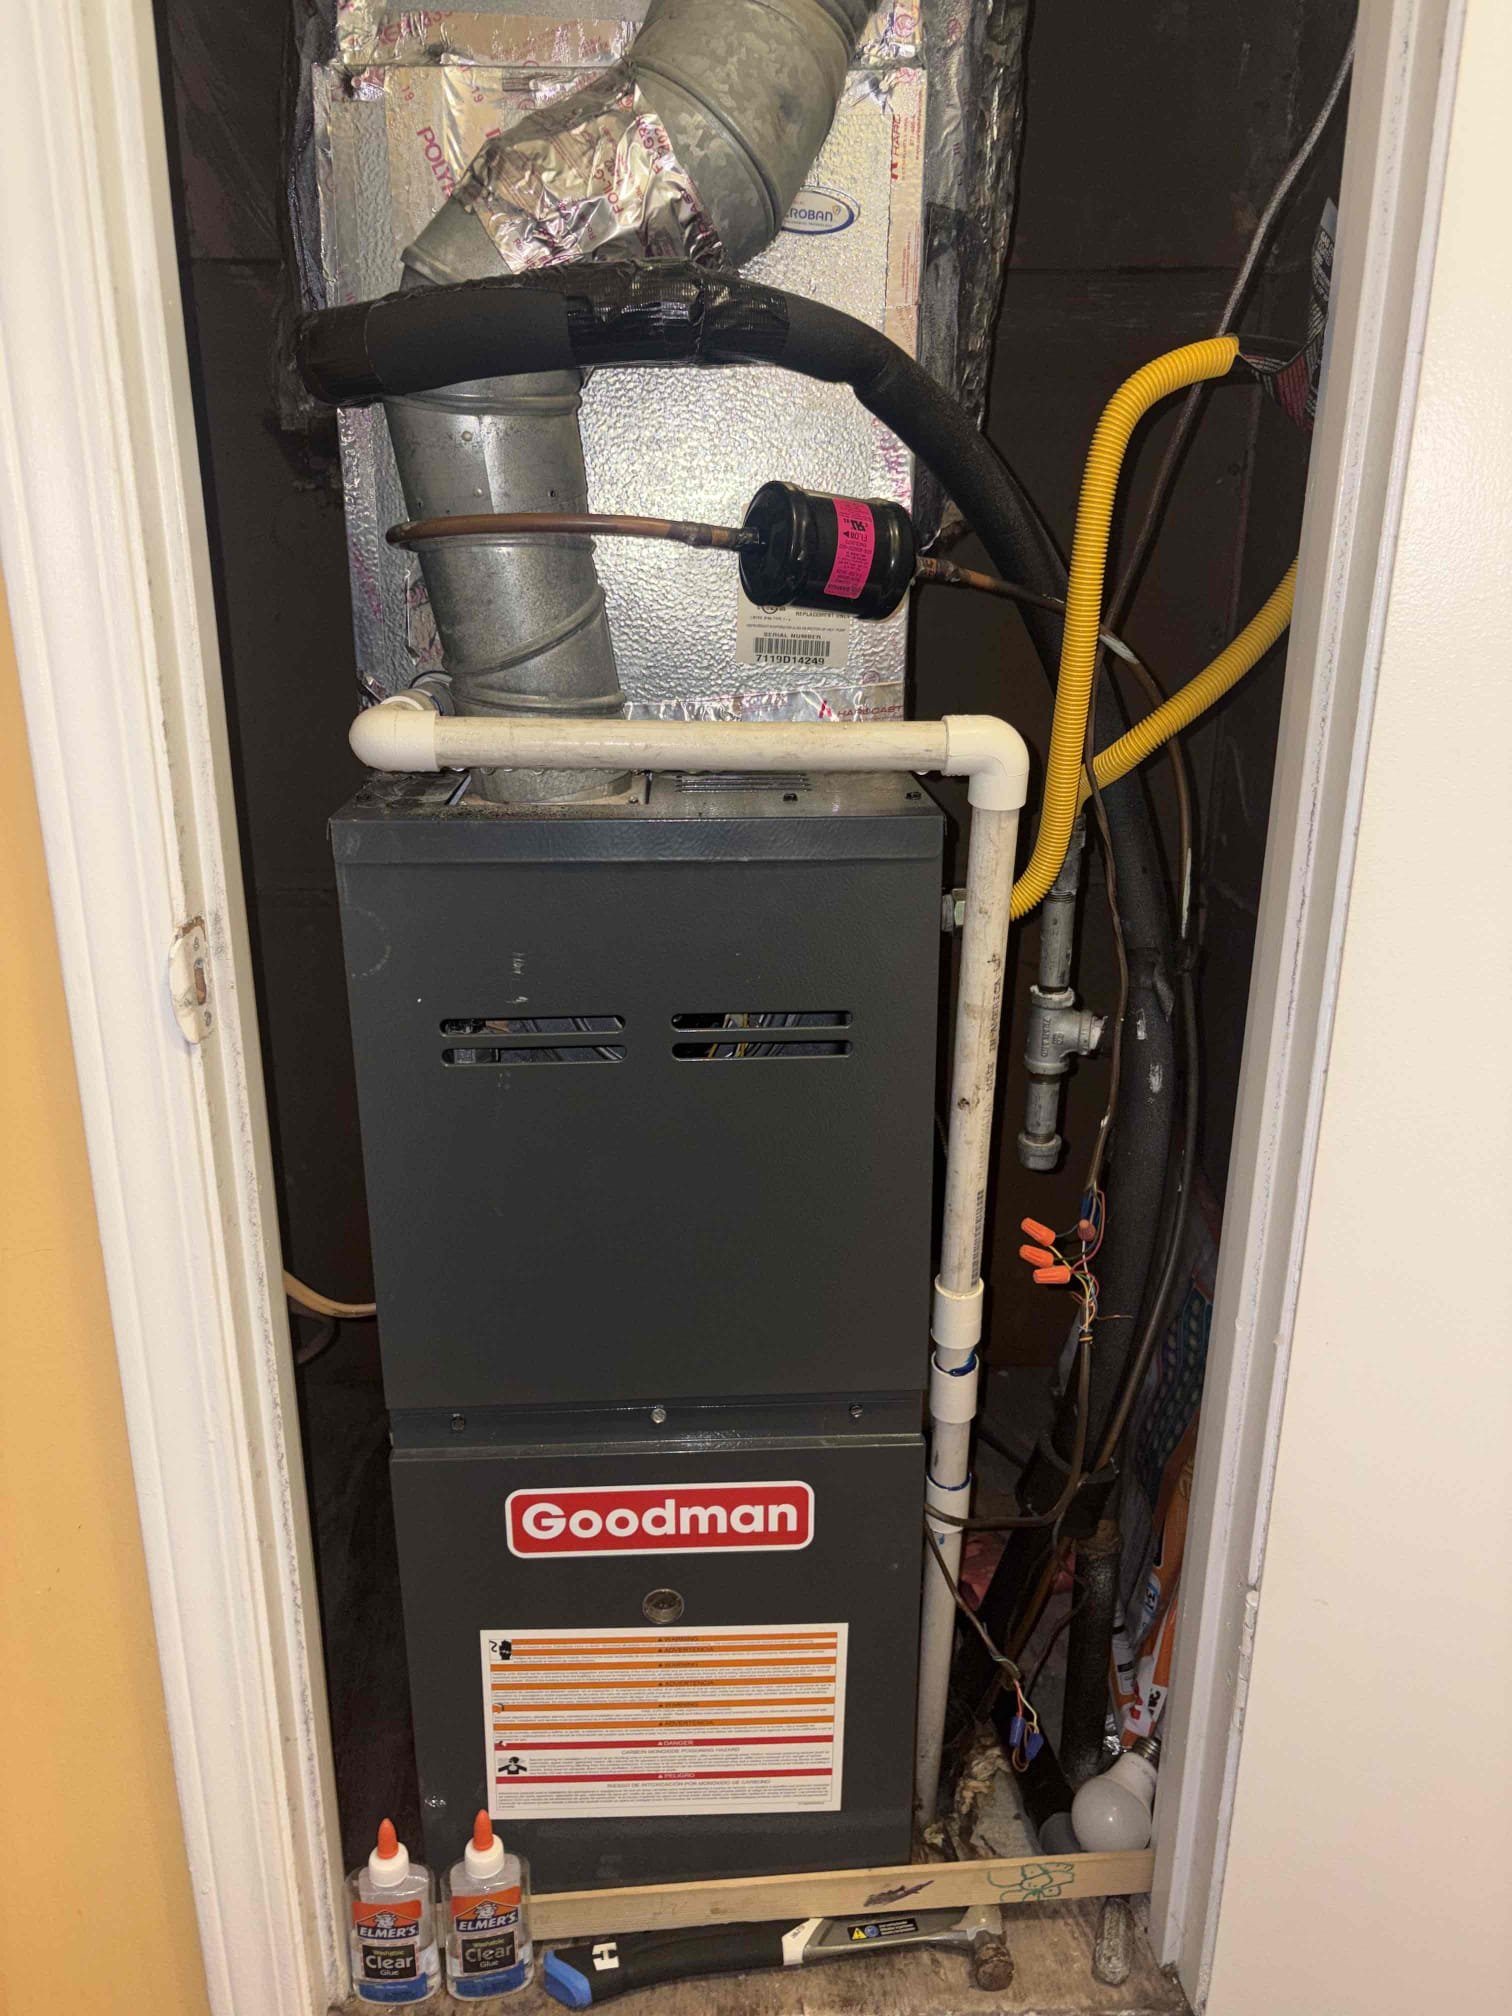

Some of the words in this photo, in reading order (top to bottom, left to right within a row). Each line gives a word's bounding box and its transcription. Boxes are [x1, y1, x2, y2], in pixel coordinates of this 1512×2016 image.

[786, 207, 834, 222] ROBAN
[756, 654, 825, 666] 7119D14249
[522, 1499, 798, 1540] Goodman
[459, 1911, 517, 1931] ELMER'S
[360, 1925, 417, 1938] ELMER'S
[465, 1945, 513, 1962] Clear
[365, 1955, 414, 1969] Clear
